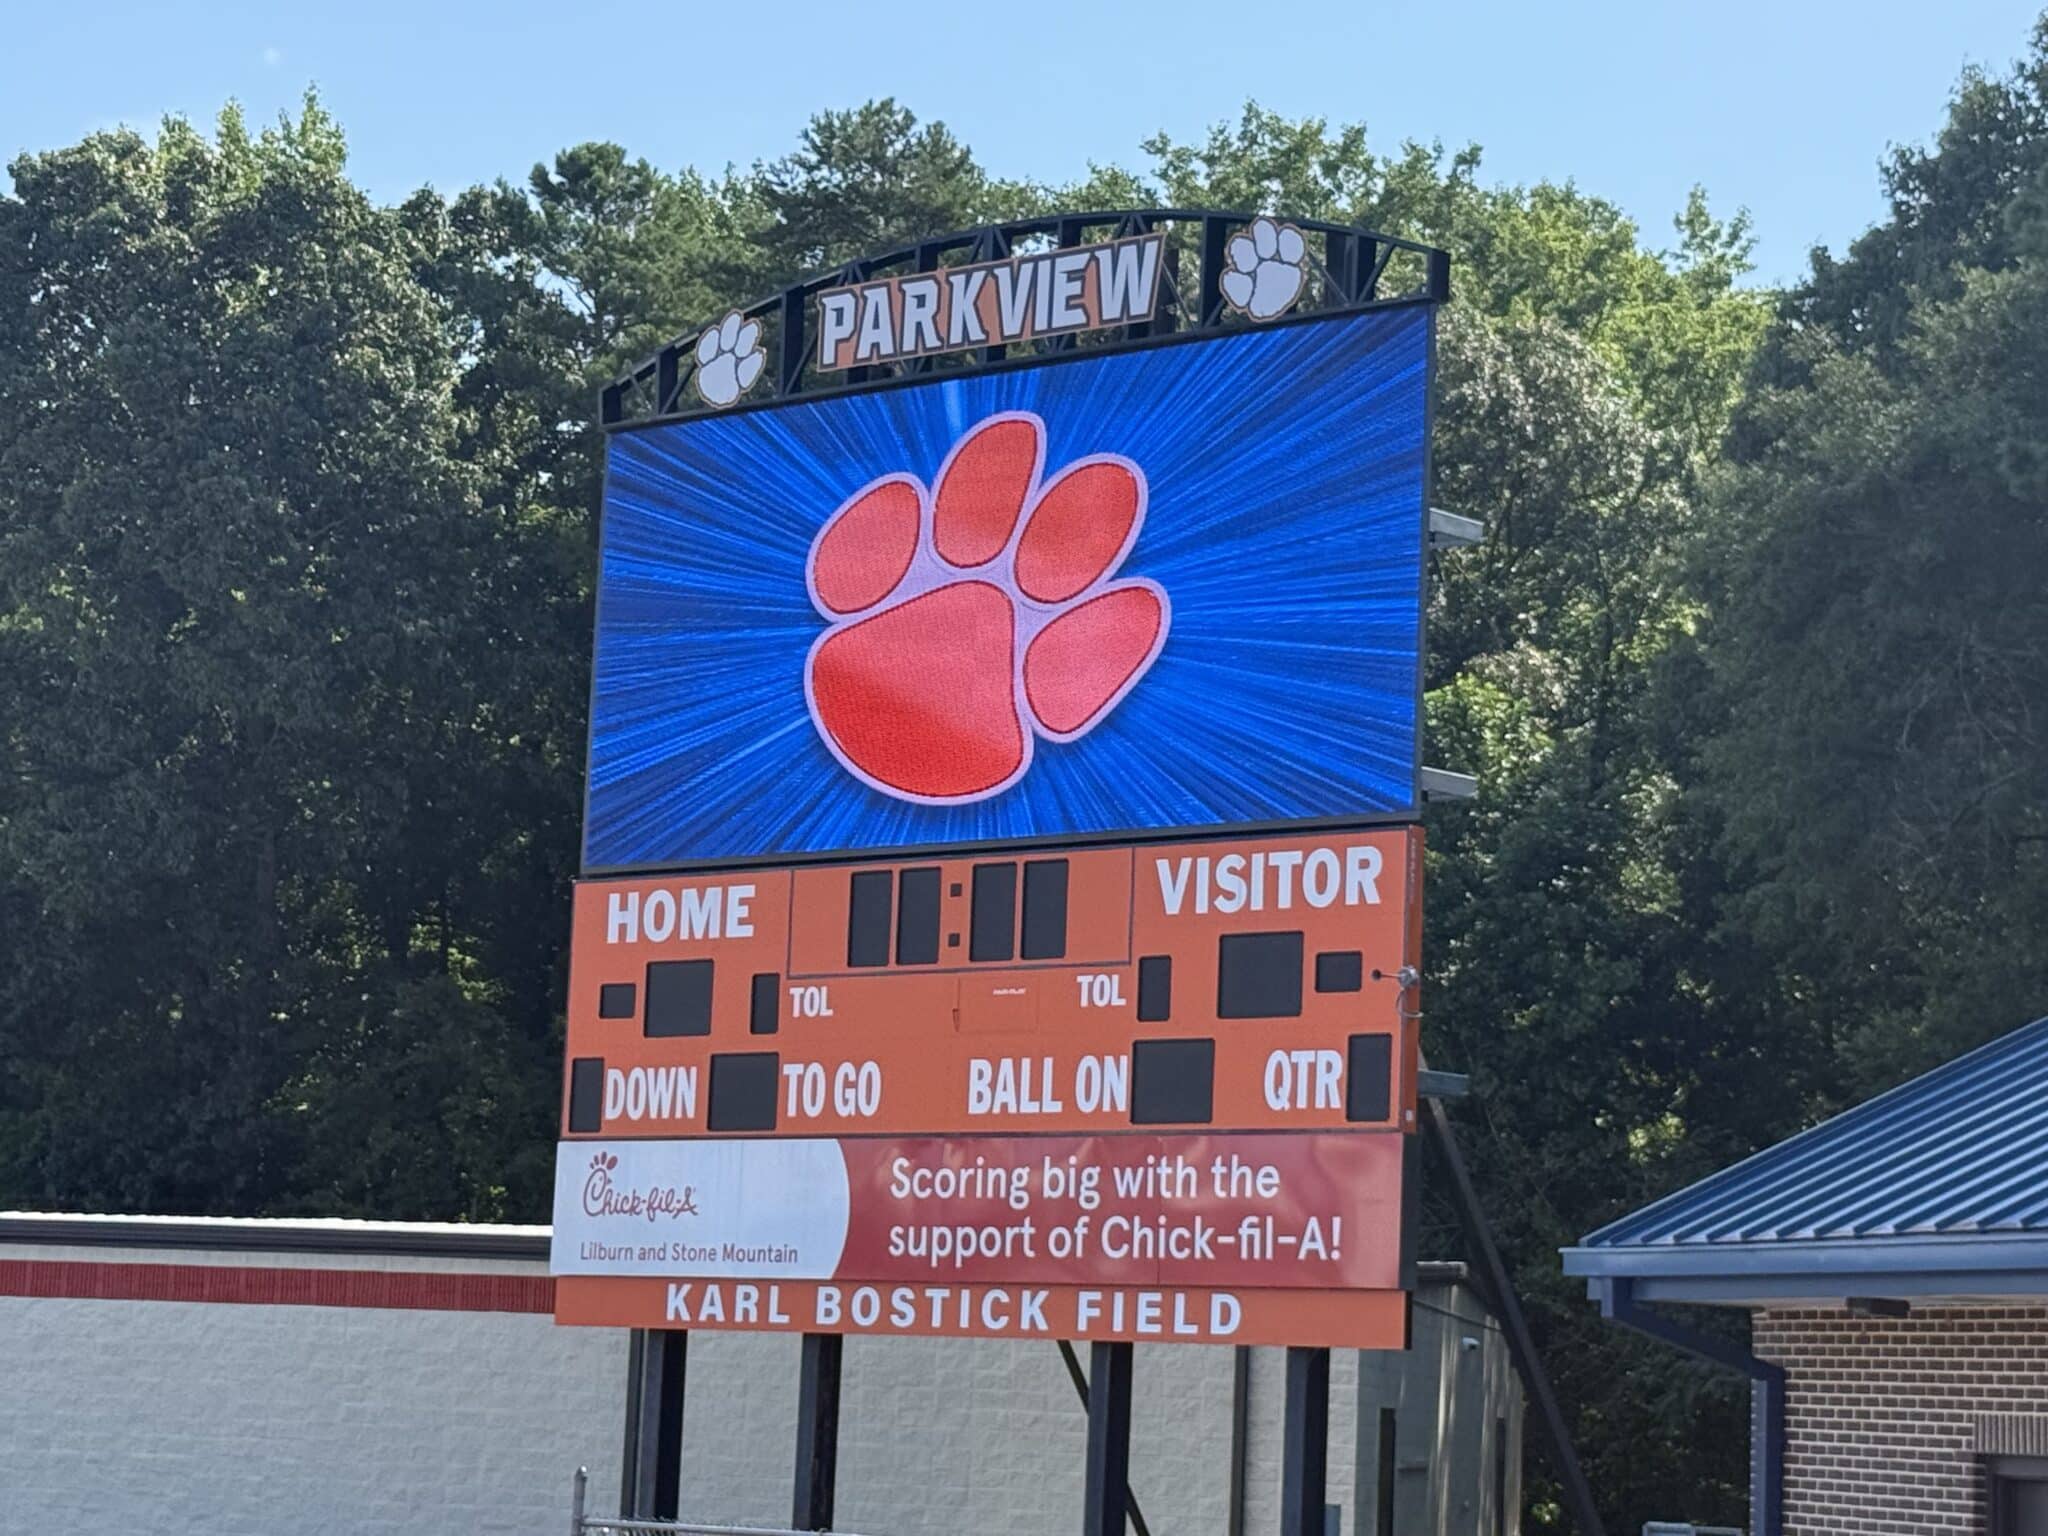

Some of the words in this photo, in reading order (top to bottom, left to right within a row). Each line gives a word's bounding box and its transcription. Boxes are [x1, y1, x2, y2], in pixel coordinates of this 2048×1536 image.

[822, 240, 1160, 366] PARKVIEW
[1155, 845, 1383, 916] VISITOR
[606, 884, 756, 944] HOME
[789, 985, 834, 1018] TOL
[1076, 973, 1127, 1008] TOL
[605, 1065, 698, 1121] DOWN
[783, 1062, 827, 1118] TO
[834, 1060, 882, 1118] GO
[967, 1056, 1063, 1115] BALL
[1074, 1054, 1129, 1113] ON
[1263, 1048, 1343, 1112] QTR
[583, 1165, 699, 1223] Chick-fil-A
[889, 1156, 1031, 1210] Scoring
[1042, 1156, 1102, 1210] big
[1113, 1155, 1198, 1200] with
[1211, 1155, 1281, 1197] the
[580, 1241, 634, 1261] Lilburn
[638, 1241, 667, 1262] and
[671, 1242, 717, 1262] Stone
[721, 1243, 799, 1264] Mountain
[888, 1215, 1036, 1268] support
[1047, 1215, 1091, 1259] of
[1101, 1215, 1343, 1261] Chick-fil-A!
[666, 1282, 791, 1325] KARL
[815, 1284, 1050, 1332] BOSTICK
[1076, 1290, 1243, 1336] FIELD
